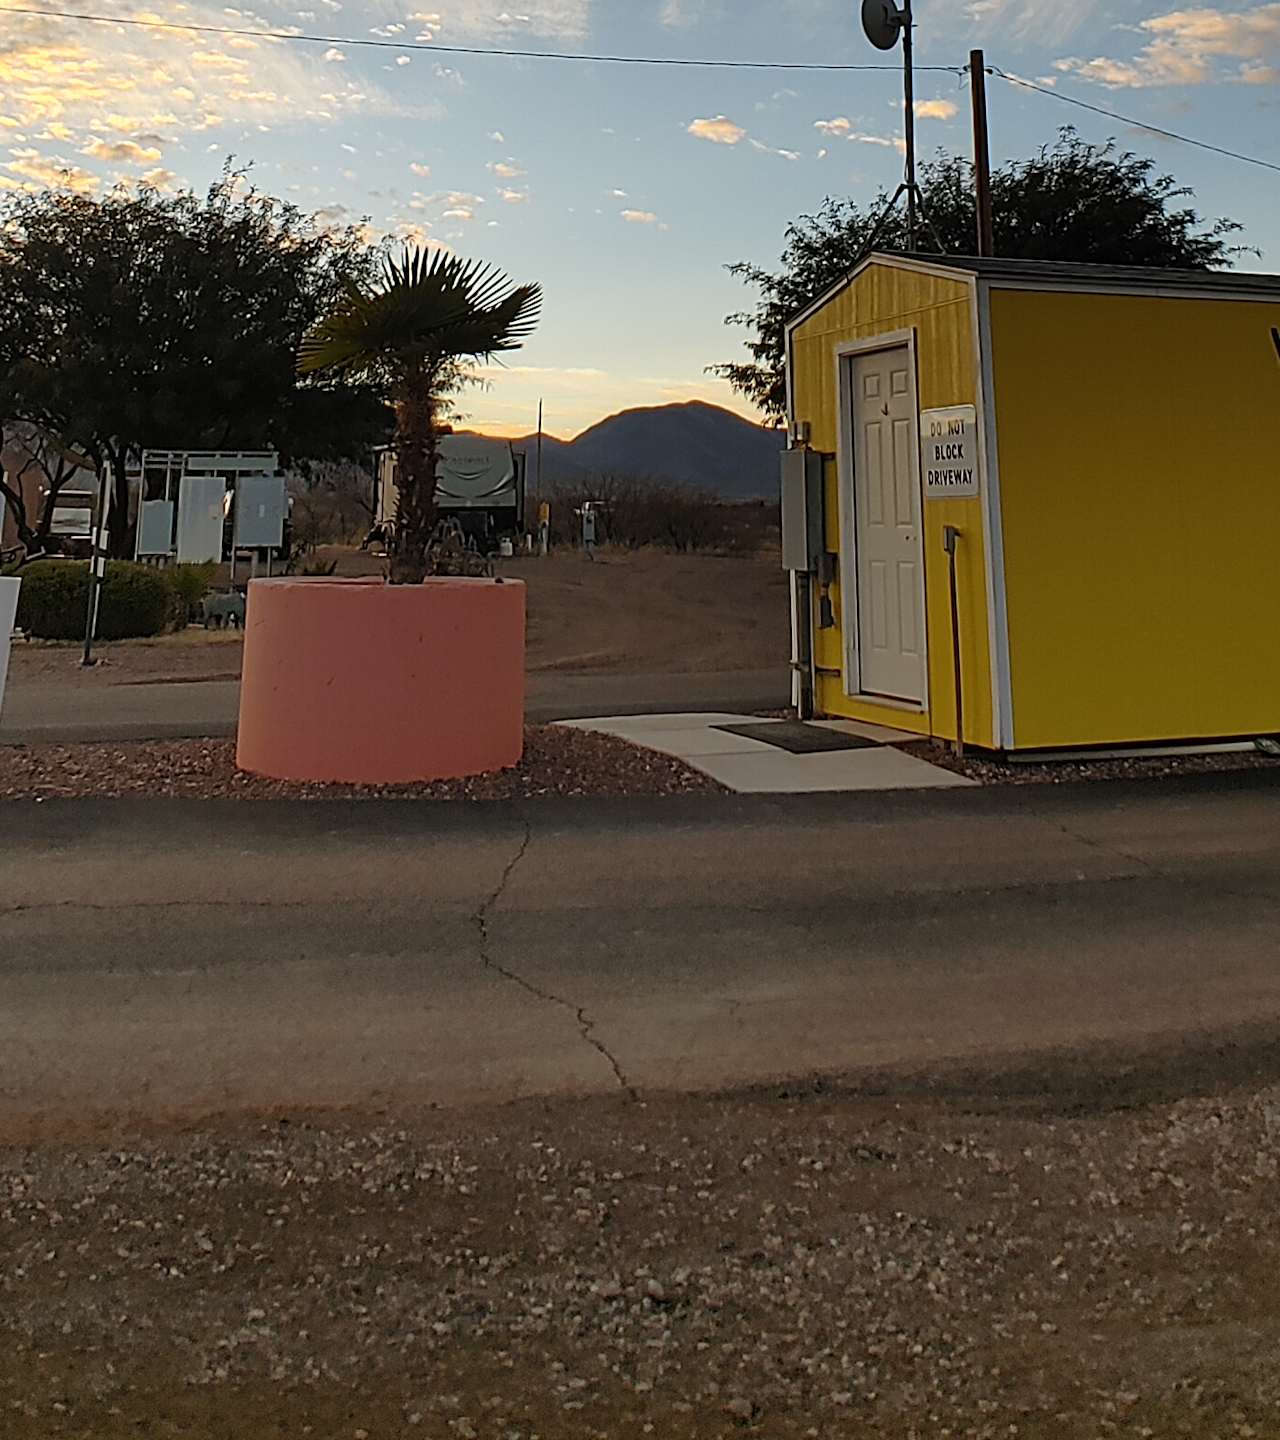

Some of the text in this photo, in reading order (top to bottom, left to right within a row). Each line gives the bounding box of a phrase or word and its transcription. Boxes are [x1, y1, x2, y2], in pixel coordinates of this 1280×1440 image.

[930, 419, 965, 437] DO NOT
[935, 443, 964, 461] BLOCK
[928, 467, 973, 487] DRIVEWAY
